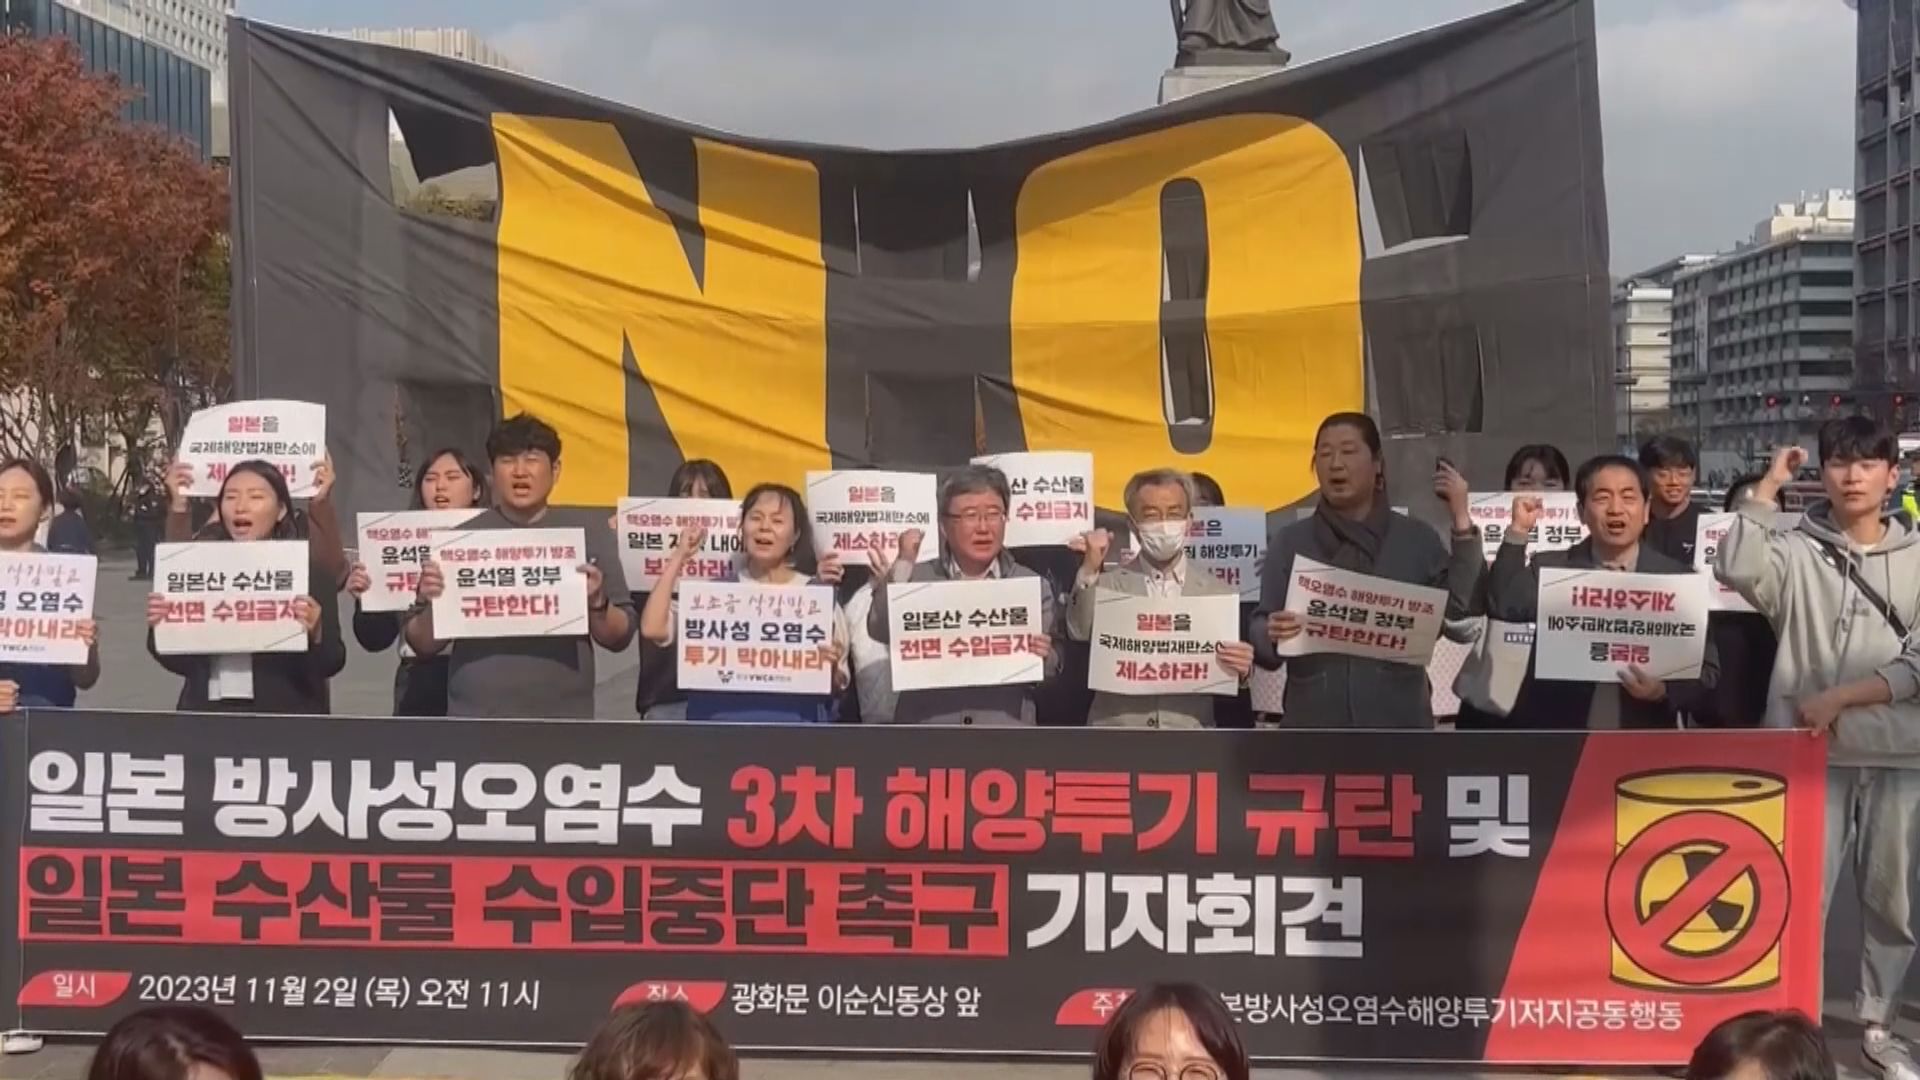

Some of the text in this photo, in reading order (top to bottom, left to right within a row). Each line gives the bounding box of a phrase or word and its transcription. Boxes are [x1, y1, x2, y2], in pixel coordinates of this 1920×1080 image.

[491, 112, 1365, 516] NO
[228, 416, 279, 433] 일본을
[848, 486, 896, 503] 일본을
[1033, 476, 1084, 494] 수산물
[1016, 501, 1088, 520] 수입금지
[1185, 520, 1223, 537] 본은
[1545, 526, 1582, 543] 정부
[628, 532, 663, 550] 일본
[1201, 544, 1258, 559] 해양투기
[456, 566, 562, 588] 윤석열 정부
[644, 558, 734, 577] 보하라!
[167, 570, 293, 592] 일본산 수산물
[17, 591, 83, 613] 오염수
[461, 595, 560, 617] 규탄한다!
[1351, 590, 1405, 611] 해양투기
[1572, 586, 1676, 611] 제소하라!
[902, 606, 1028, 631] 일본산 수산물
[1137, 614, 1191, 632] 일본을
[1307, 599, 1415, 631] 윤석열 정부
[685, 619, 826, 644] 방사성 오염수
[1305, 622, 1407, 650] 규탄한다!
[685, 645, 727, 667] 투기
[900, 637, 942, 660] 전면
[1590, 642, 1650, 664] 일본을
[1116, 661, 1208, 681] 제소하라!
[28, 750, 1531, 857] 일본 방사성오염수 3차 해양투기 규탄 및
[26, 854, 1364, 958] 일본 수산물 수입중단 촉구 기자회견
[53, 973, 95, 998] 일시
[139, 975, 541, 1010] 2023년 11월 2일 (목) 오전 11시
[731, 983, 981, 1018] 광화문 이순신동상 앞
[1220, 992, 1684, 1032] 본방사성오염수해양투기저지공동행동
